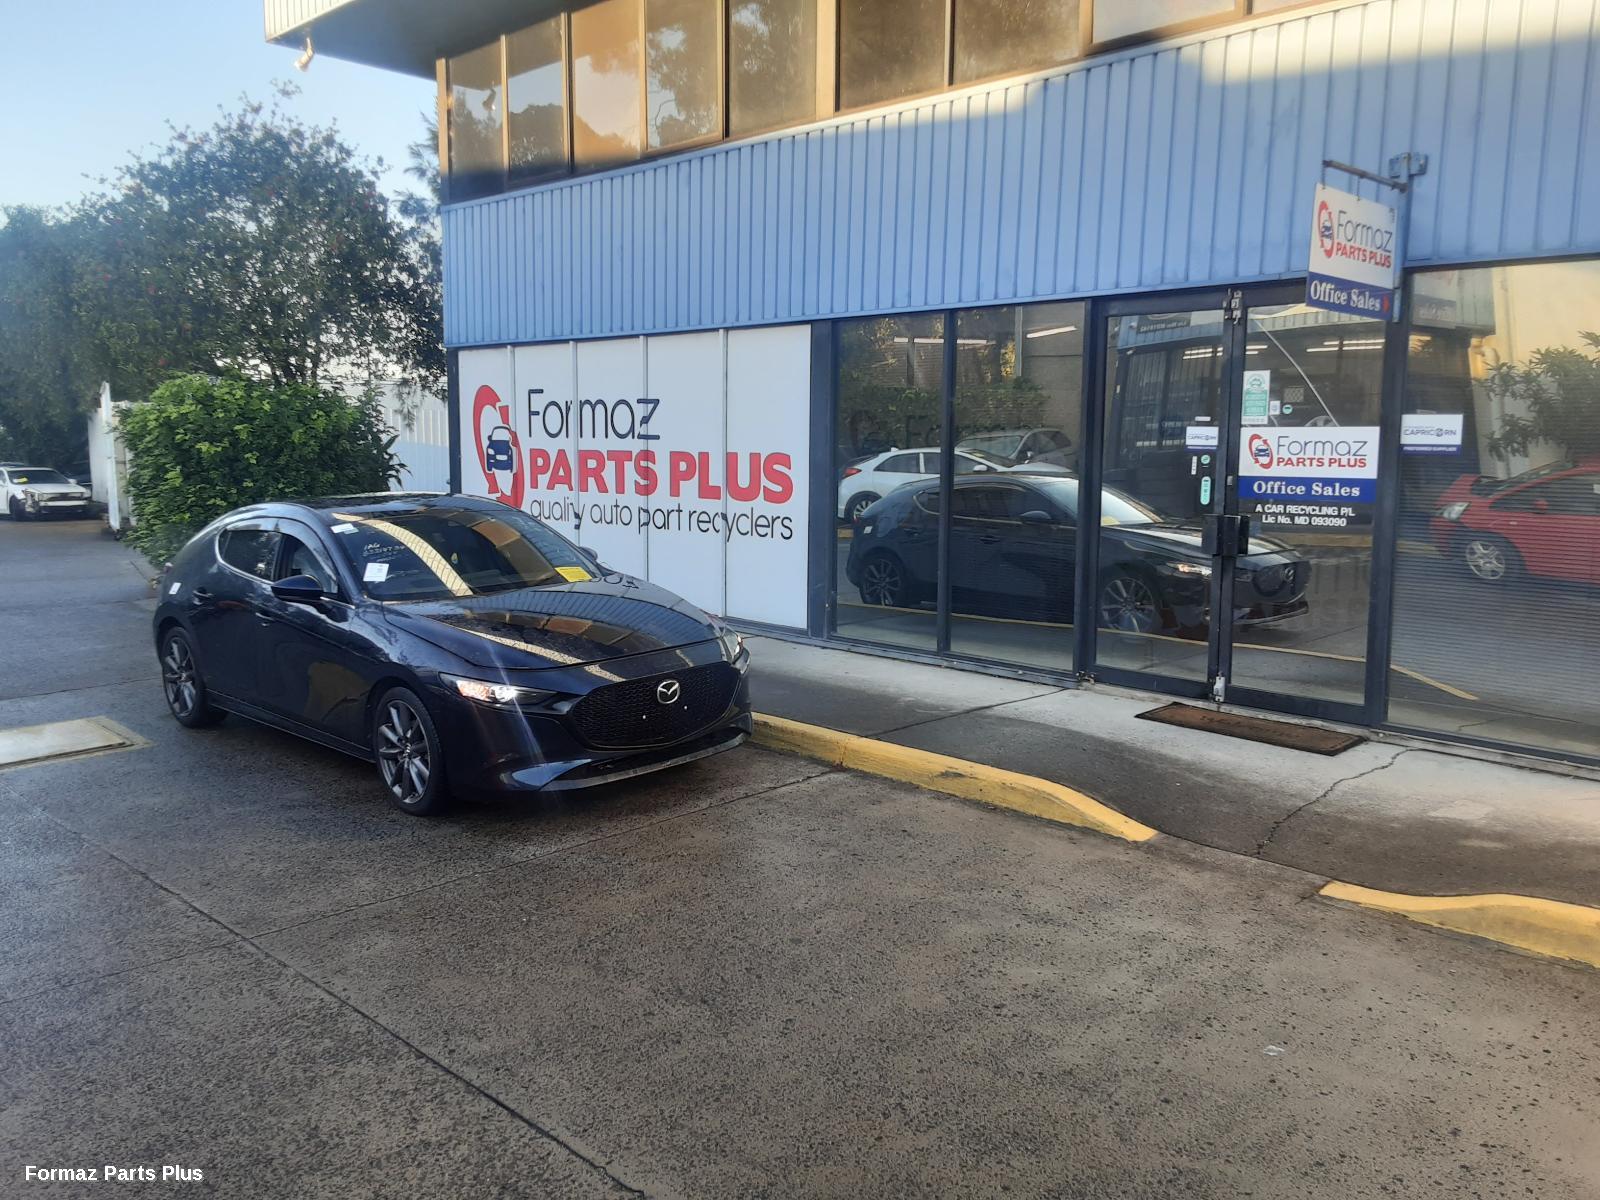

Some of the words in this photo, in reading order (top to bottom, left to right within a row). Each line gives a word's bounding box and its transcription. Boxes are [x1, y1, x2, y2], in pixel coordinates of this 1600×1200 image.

[1336, 210, 1393, 253] Formaz
[1335, 242, 1367, 262] PARTS
[1369, 251, 1392, 268] PLUS
[1310, 280, 1348, 305] Office
[1350, 289, 1381, 311] Sales
[528, 388, 661, 441] Formaz
[1277, 435, 1368, 457] Formaz
[1277, 457, 1324, 468] PARTS
[1328, 457, 1367, 468] PLUS
[529, 448, 659, 497] PARTS
[670, 451, 794, 505] PLUS
[1253, 480, 1306, 495] Office
[1311, 482, 1361, 497] Sales
[530, 496, 586, 530] qualiy
[590, 498, 633, 526] auto
[638, 504, 684, 535] part
[689, 507, 794, 543] recyclers
[1255, 503, 1263, 513] A
[1264, 504, 1284, 513] CAR
[1286, 505, 1339, 516] RECYCLING
[1262, 515, 1275, 523] Lic
[1277, 515, 1292, 524] No.
[1294, 516, 1309, 525] MD
[1311, 516, 1347, 527] 093090
